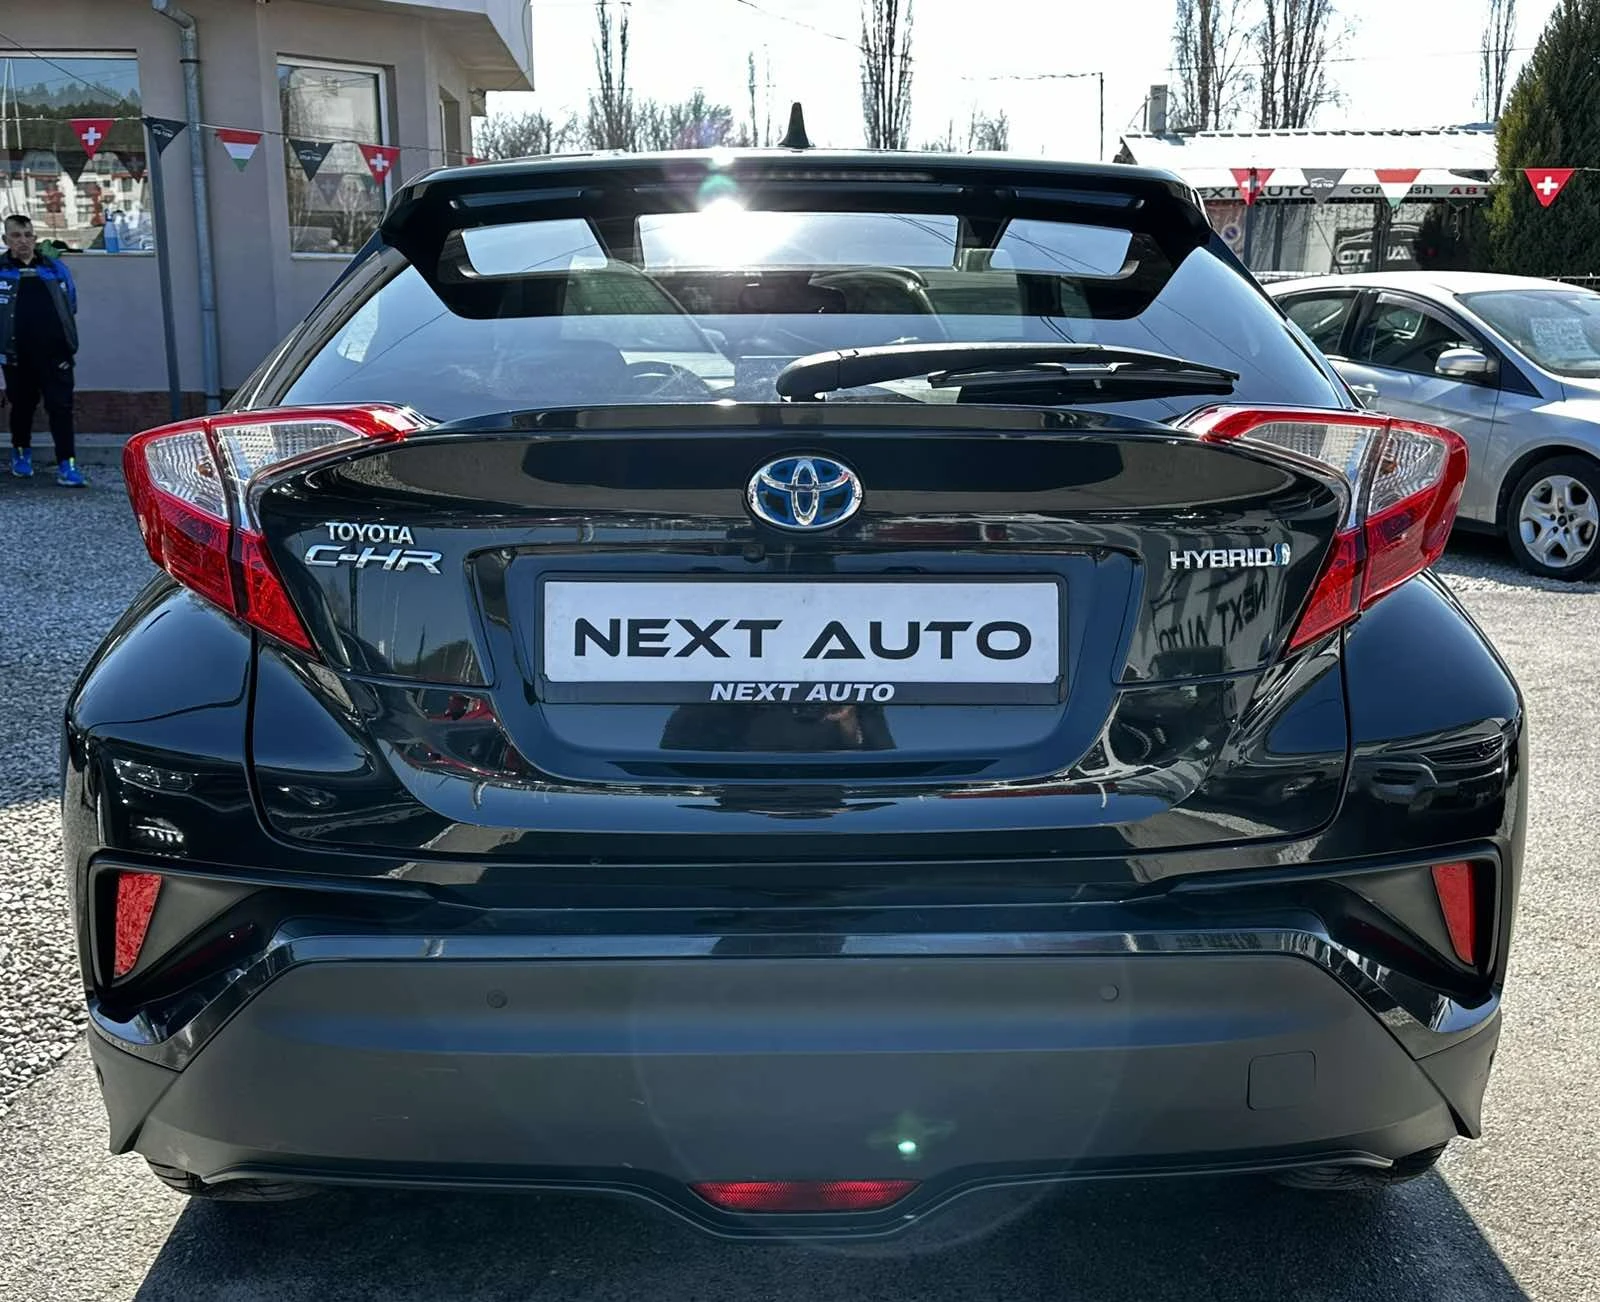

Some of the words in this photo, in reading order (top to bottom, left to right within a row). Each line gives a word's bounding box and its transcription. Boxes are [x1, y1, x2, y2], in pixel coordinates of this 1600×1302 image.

[1197, 187, 1241, 198] EXT
[1405, 184, 1433, 195] ash
[1449, 186, 1490, 195] АВТ
[325, 521, 415, 545] TOYOTA
[304, 544, 442, 574] C-HR
[1169, 547, 1273, 570] HYBRID
[574, 617, 784, 658] NEXT
[802, 620, 1033, 660] AUTO
[710, 682, 800, 701] NEXT
[805, 683, 896, 702] AUTO
